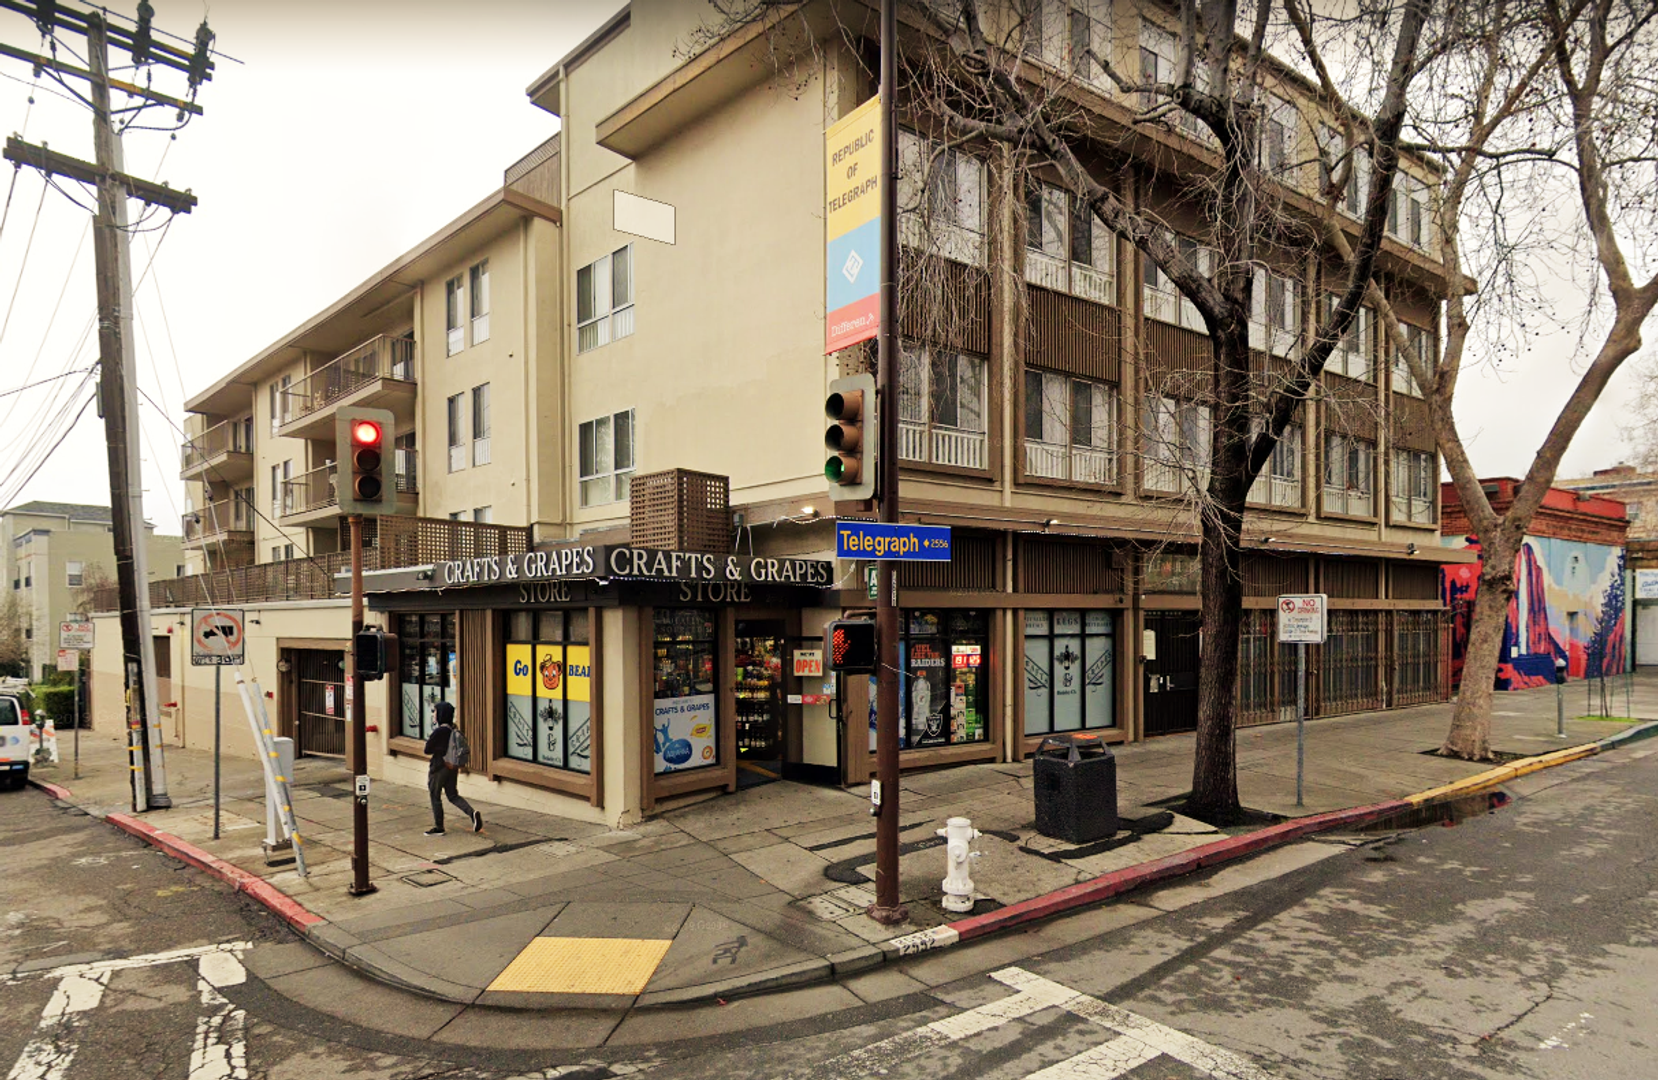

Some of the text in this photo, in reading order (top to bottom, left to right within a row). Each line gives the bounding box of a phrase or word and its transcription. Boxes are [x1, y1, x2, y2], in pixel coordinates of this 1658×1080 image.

[832, 129, 874, 166] REPUBLIC
[847, 162, 858, 180] OF
[829, 175, 878, 214] TELEGRAPH
[840, 530, 919, 556] Telegraph
[444, 546, 594, 584] CRAFTS & GRAPES
[610, 547, 827, 583] CRAFTS & GRAPES
[519, 582, 572, 603] STORE
[679, 582, 752, 602] STORE
[1302, 599, 1316, 607] NO
[796, 659, 821, 673] OPEN
[911, 658, 945, 667] RAIDERS
[1025, 660, 1048, 684] RAFTS
[655, 705, 679, 716] CRAFTS
[680, 705, 686, 714] &
[686, 702, 710, 713] GRAPES
